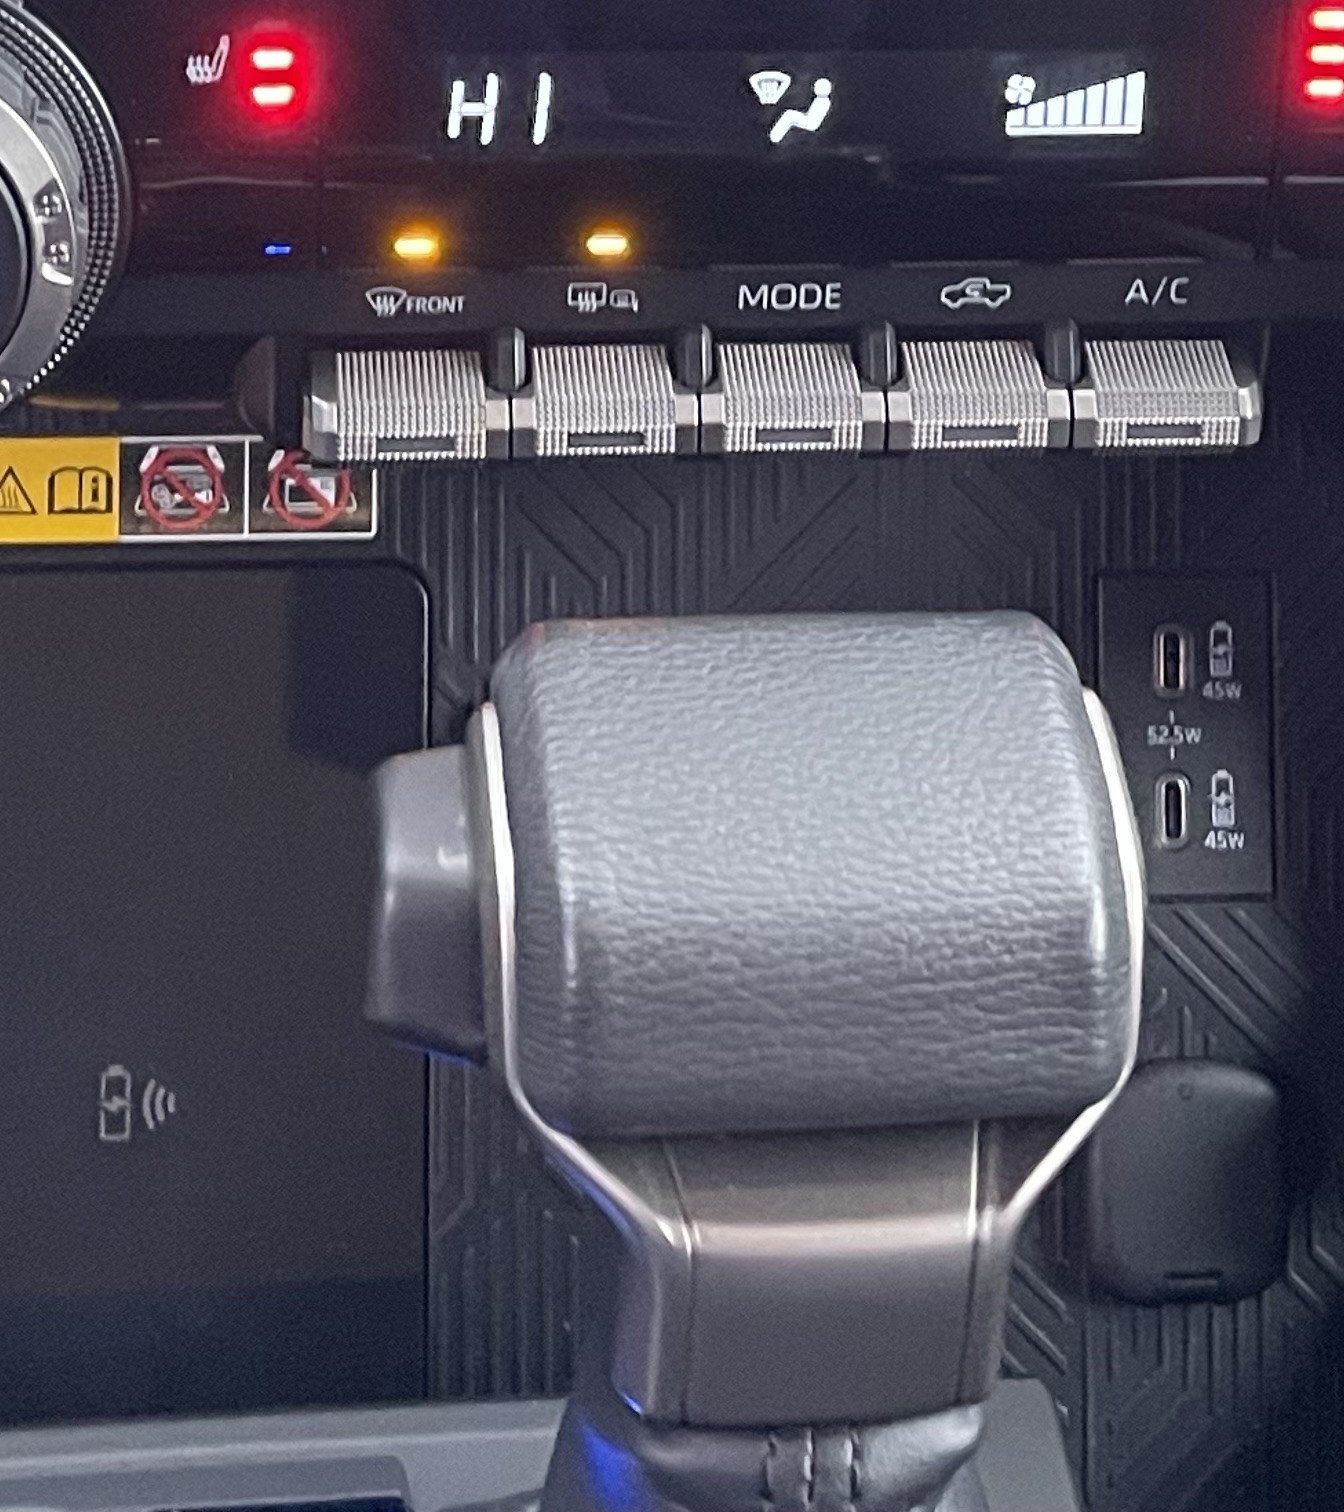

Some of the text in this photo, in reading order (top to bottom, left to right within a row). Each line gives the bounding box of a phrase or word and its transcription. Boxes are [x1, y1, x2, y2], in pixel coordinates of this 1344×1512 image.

[447, 71, 552, 146] HI
[738, 282, 841, 310] MODE
[1124, 276, 1189, 306] A/C
[406, 295, 464, 314] FRONT
[1202, 681, 1242, 699] 45W
[1204, 830, 1245, 850] 45W
